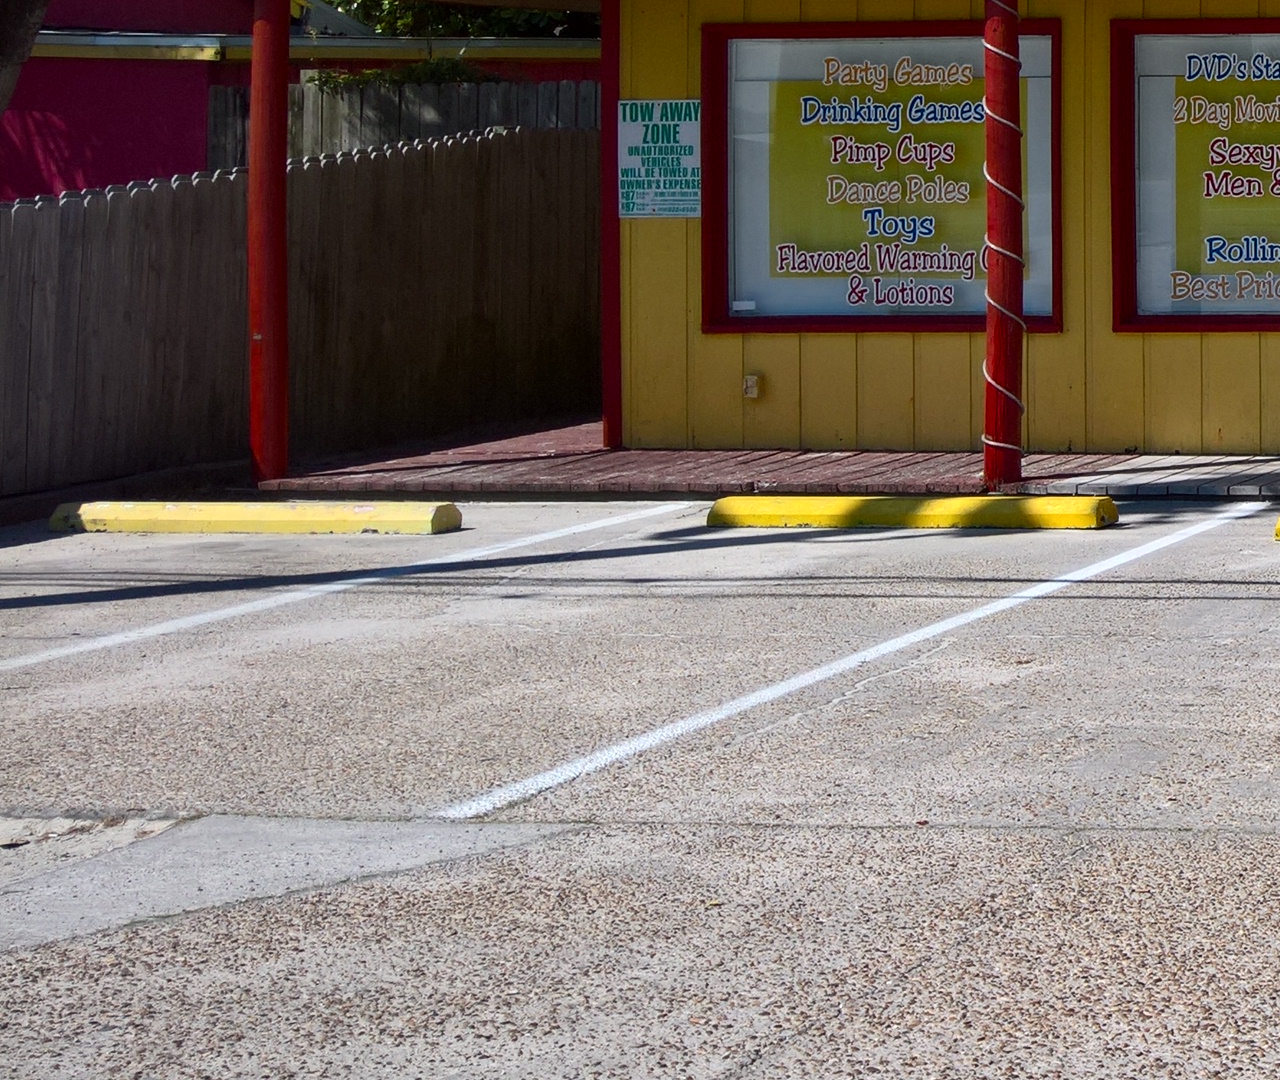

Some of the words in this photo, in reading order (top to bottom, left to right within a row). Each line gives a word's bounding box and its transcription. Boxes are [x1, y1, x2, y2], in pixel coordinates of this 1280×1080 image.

[823, 57, 888, 92] Party
[893, 56, 973, 86] Games
[1186, 53, 1246, 80] DVD's
[620, 102, 654, 122] TOW
[660, 102, 700, 121] AWAY
[801, 96, 902, 132] Drinking
[907, 95, 986, 123] Games
[1172, 95, 1187, 123] 2
[1190, 95, 1231, 130] Day
[642, 124, 680, 144] ZONE
[628, 145, 694, 156] UNAUTHORIZED
[641, 156, 681, 167] VEHICLES
[831, 135, 891, 171] Pimp
[897, 134, 955, 171] Cups
[620, 179, 661, 190] OWNER'S
[663, 179, 700, 190] EXPENSE
[621, 168, 642, 178] WILL
[645, 168, 655, 178] BE
[659, 167, 688, 178] TOWED
[690, 167, 700, 178] AT
[1203, 172, 1263, 198] Men
[826, 175, 900, 205] Dance
[905, 174, 969, 204] Poles
[863, 207, 935, 243] Toys
[776, 243, 870, 272] Flavored
[875, 242, 976, 280] Warming
[847, 275, 869, 305] &
[873, 278, 954, 306] Lotions
[1170, 271, 1231, 300] Best
